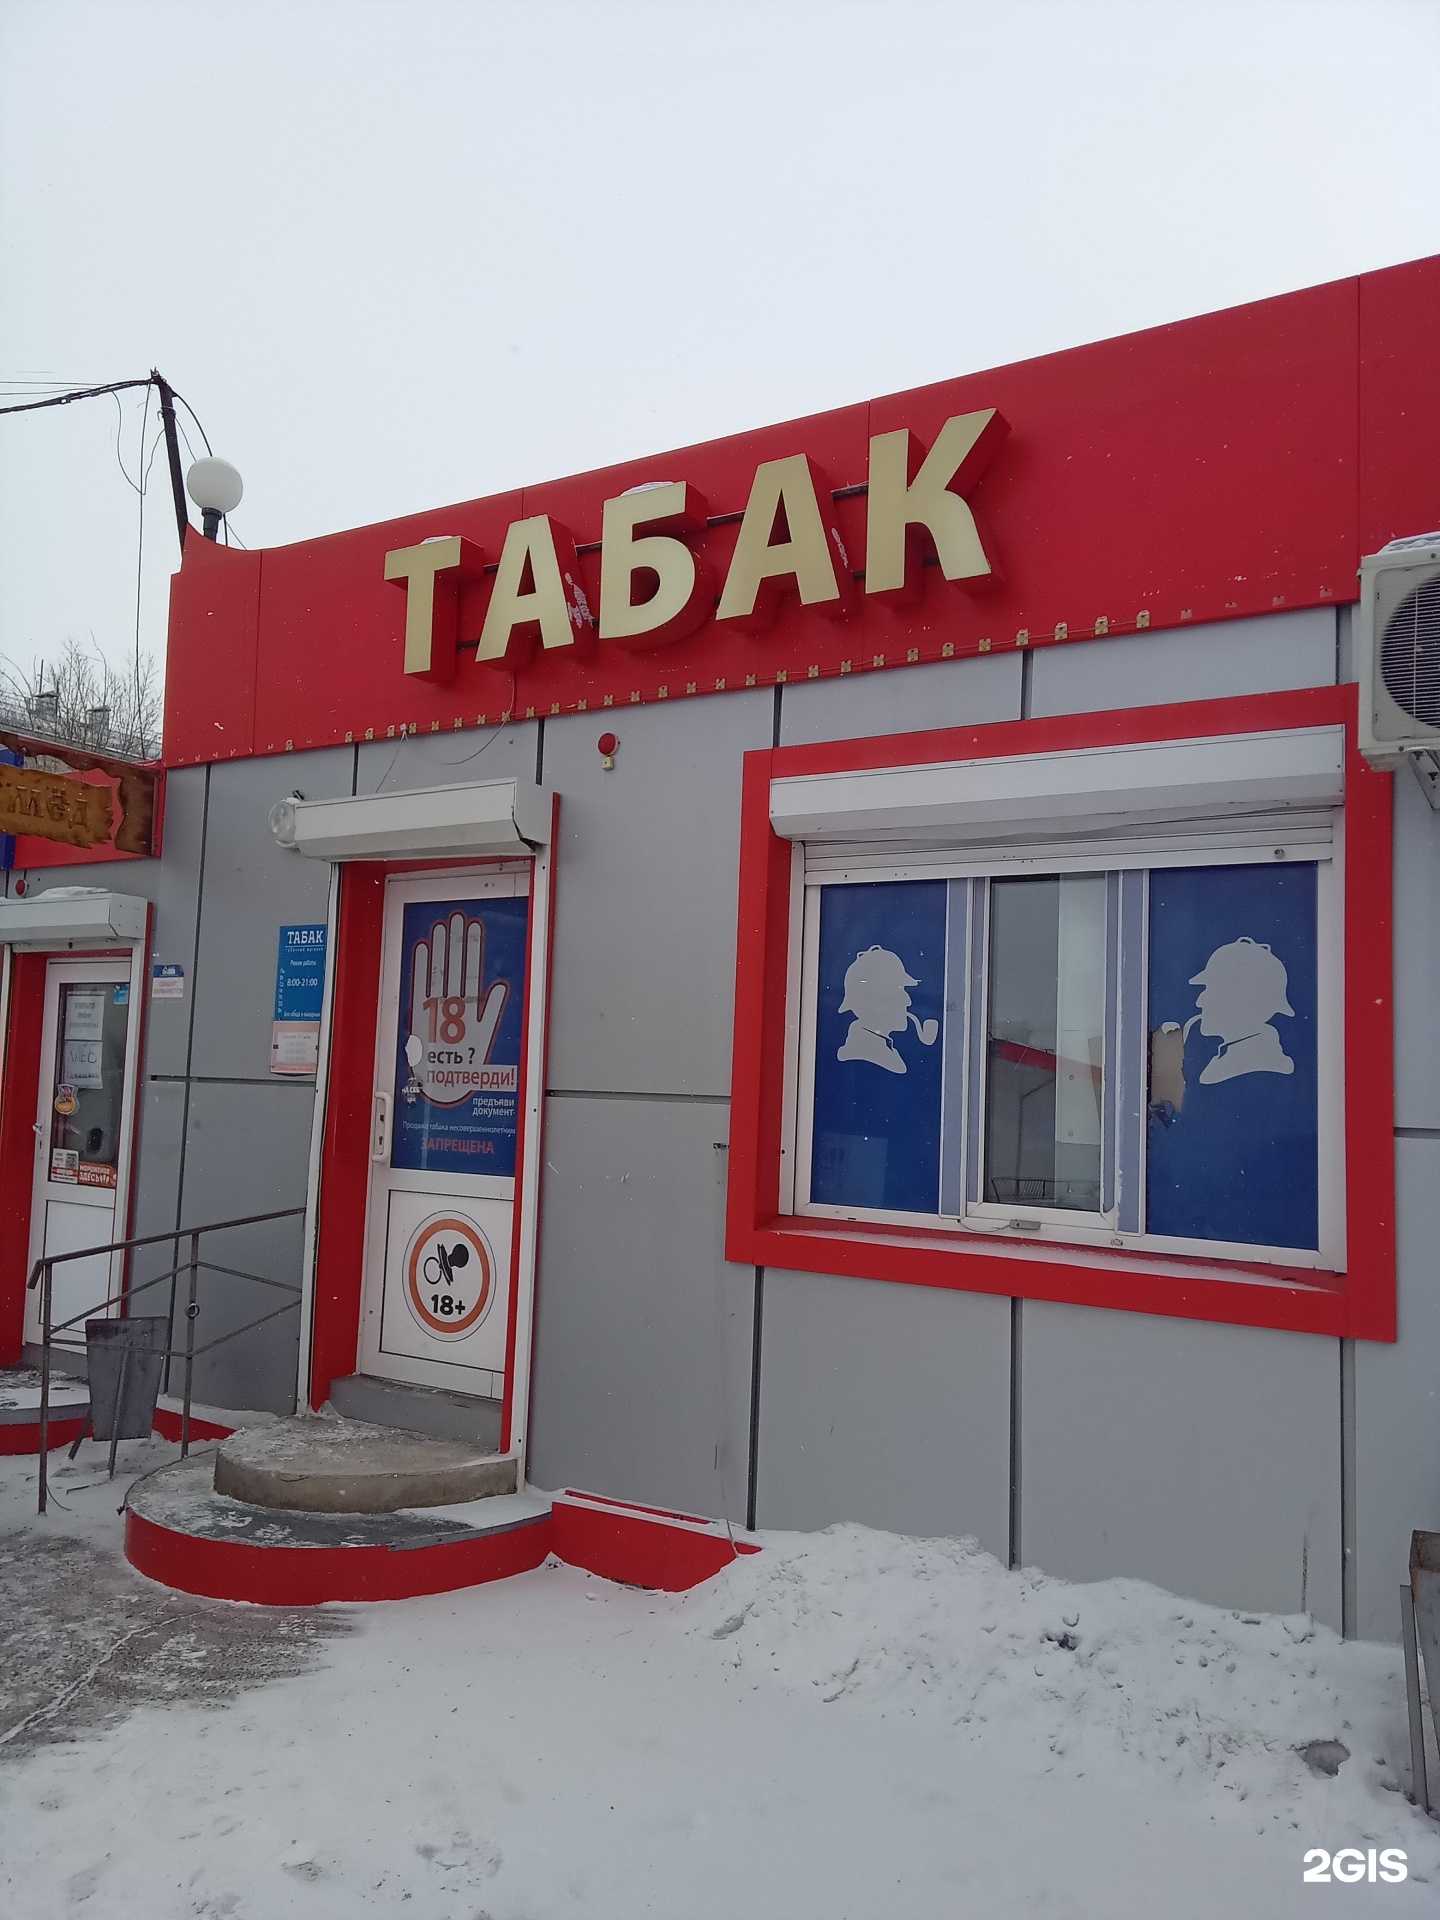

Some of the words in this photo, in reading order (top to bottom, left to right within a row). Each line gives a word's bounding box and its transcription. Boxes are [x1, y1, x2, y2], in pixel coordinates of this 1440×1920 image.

[383, 408, 998, 675] ТАБАК
[287, 930, 324, 945] ТАБАК
[422, 996, 466, 1045] 18
[427, 1051, 463, 1064] есть
[427, 1068, 515, 1088] подтверди!
[472, 1097, 515, 1108] предъяви
[421, 1137, 495, 1155] ЗАПРЕЩЕНА
[431, 1294, 466, 1316] 18+
